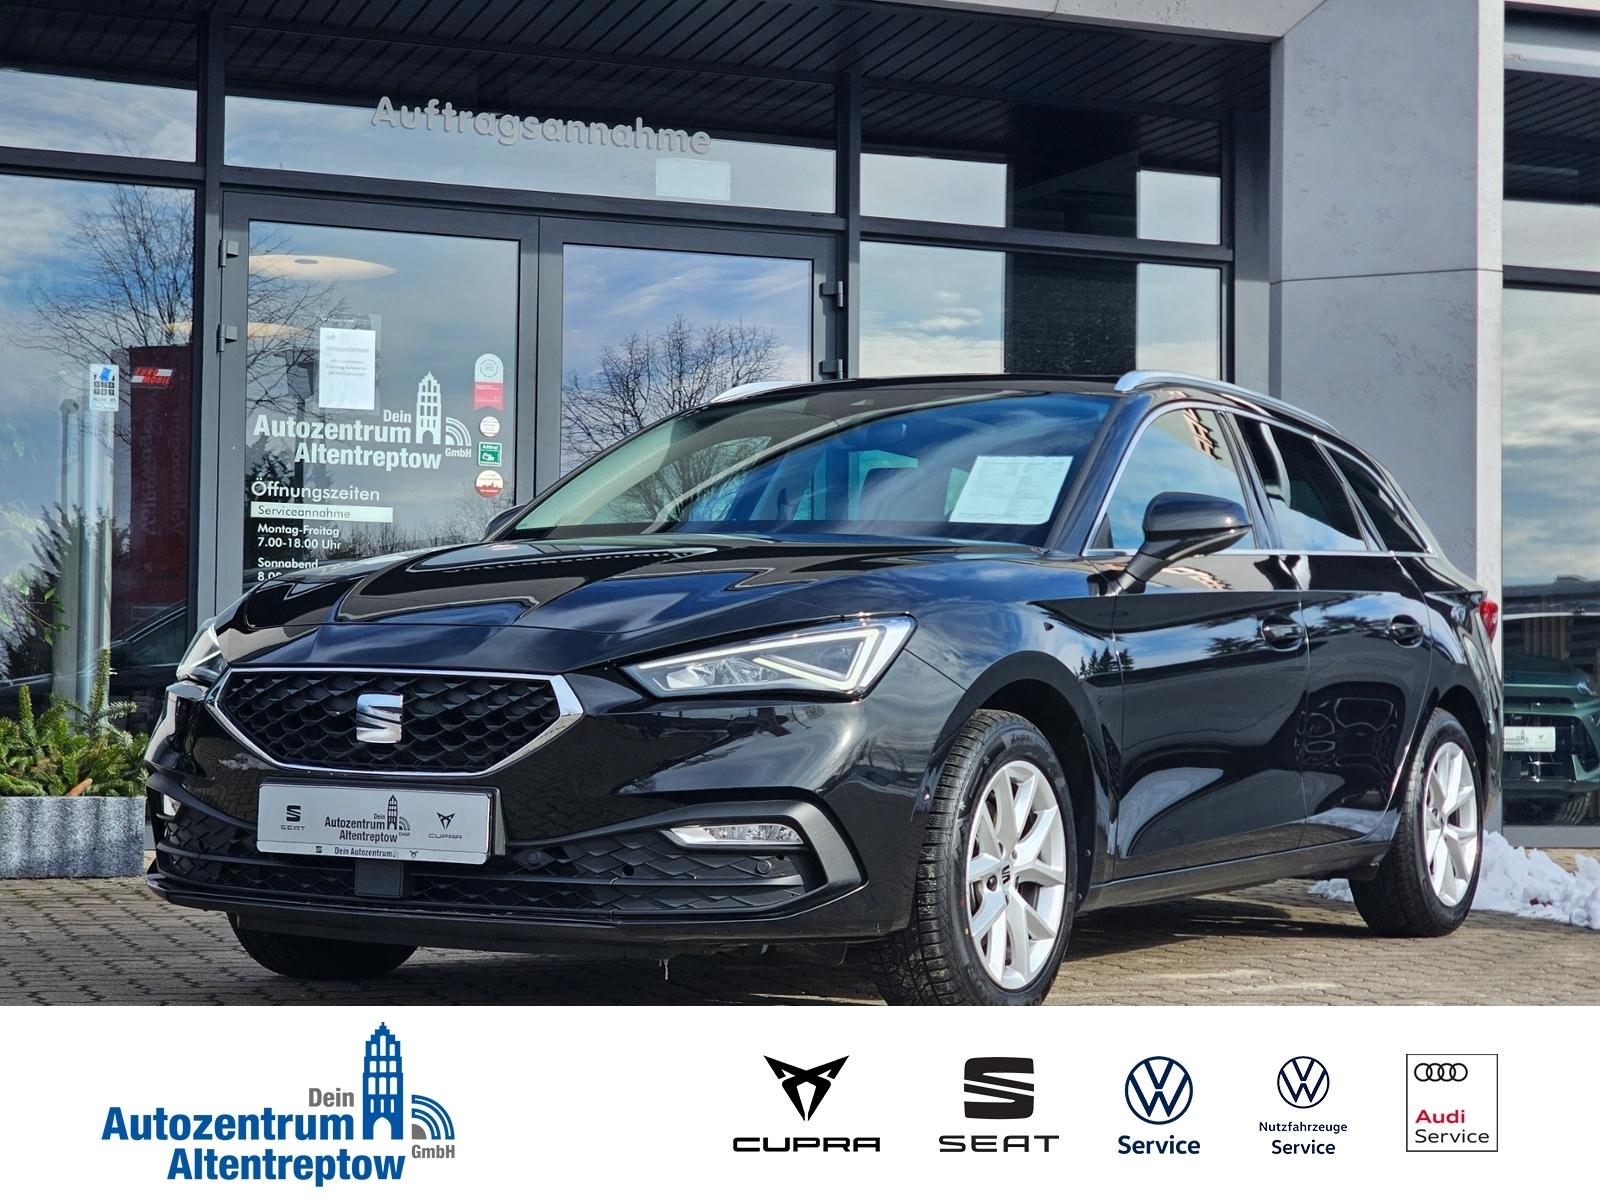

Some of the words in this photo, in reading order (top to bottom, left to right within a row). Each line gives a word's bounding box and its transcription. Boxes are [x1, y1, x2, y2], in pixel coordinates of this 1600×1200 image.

[371, 96, 712, 154] Auftragsannahme
[383, 409, 412, 424] Dein
[252, 414, 411, 444] Autozentrum
[294, 442, 442, 472] Altentreptow
[445, 447, 472, 458] GmbH
[251, 477, 380, 502] Öffnungszeiten
[258, 504, 351, 519] Serviceannahme
[257, 524, 340, 538] Montag-Freitag
[257, 538, 319, 550] 7.00-18.00
[322, 539, 342, 550] Uhr
[257, 557, 319, 569] Sonnabend
[324, 816, 386, 830] Autozentrum
[339, 829, 398, 844] Altentreptow
[334, 846, 349, 855] Dein
